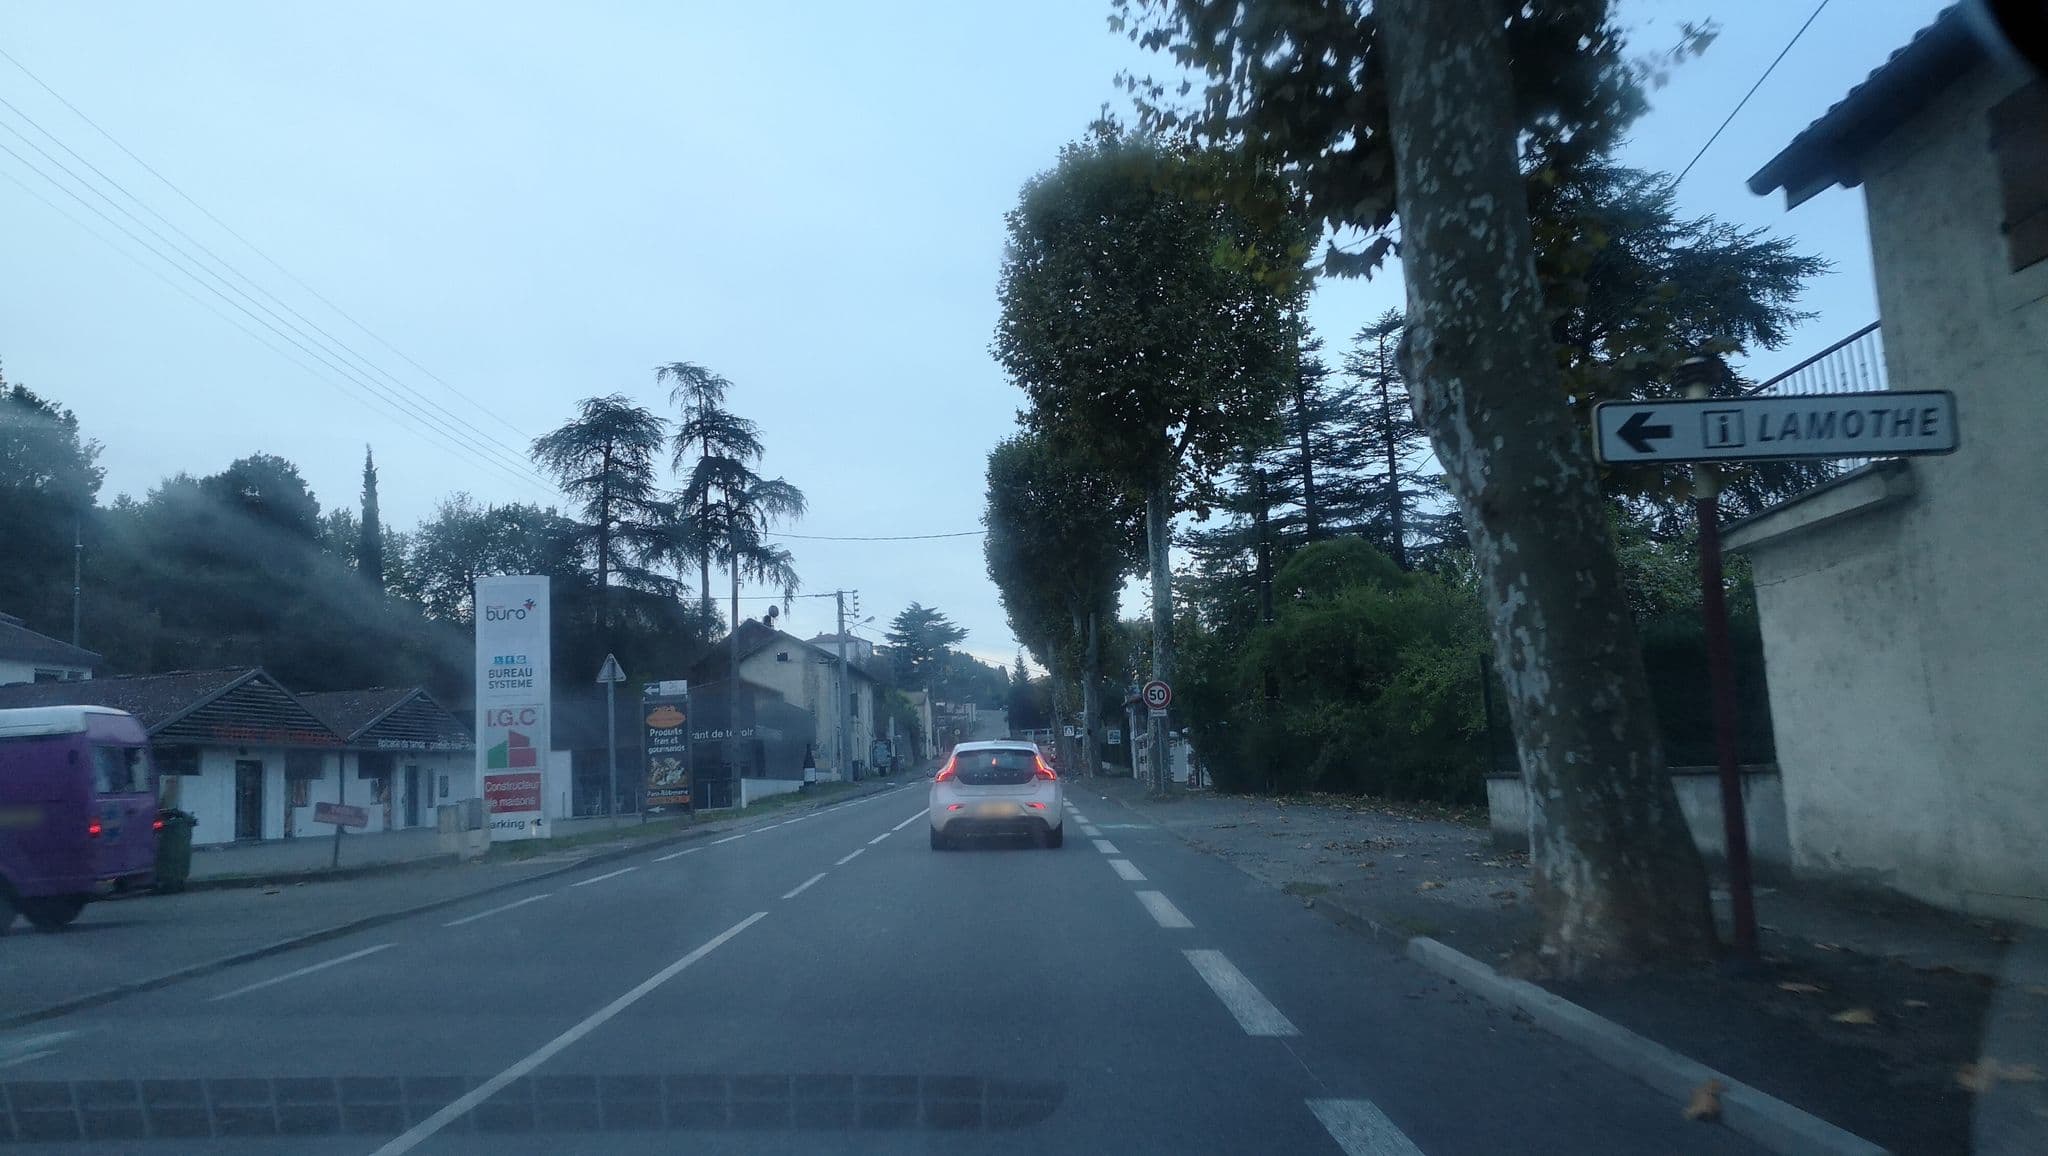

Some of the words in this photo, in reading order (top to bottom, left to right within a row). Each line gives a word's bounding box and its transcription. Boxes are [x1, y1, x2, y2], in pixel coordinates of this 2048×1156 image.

[1756, 407, 1939, 442] LAMOTHE
[488, 667, 533, 679] BUREAU
[488, 679, 533, 690] SYSTEME
[1150, 690, 1165, 701] 50
[487, 708, 536, 728] I.G.C
[711, 729, 724, 739] de
[486, 780, 538, 792] Constructeur
[499, 797, 536, 807] maisons
[488, 819, 525, 830] arking
